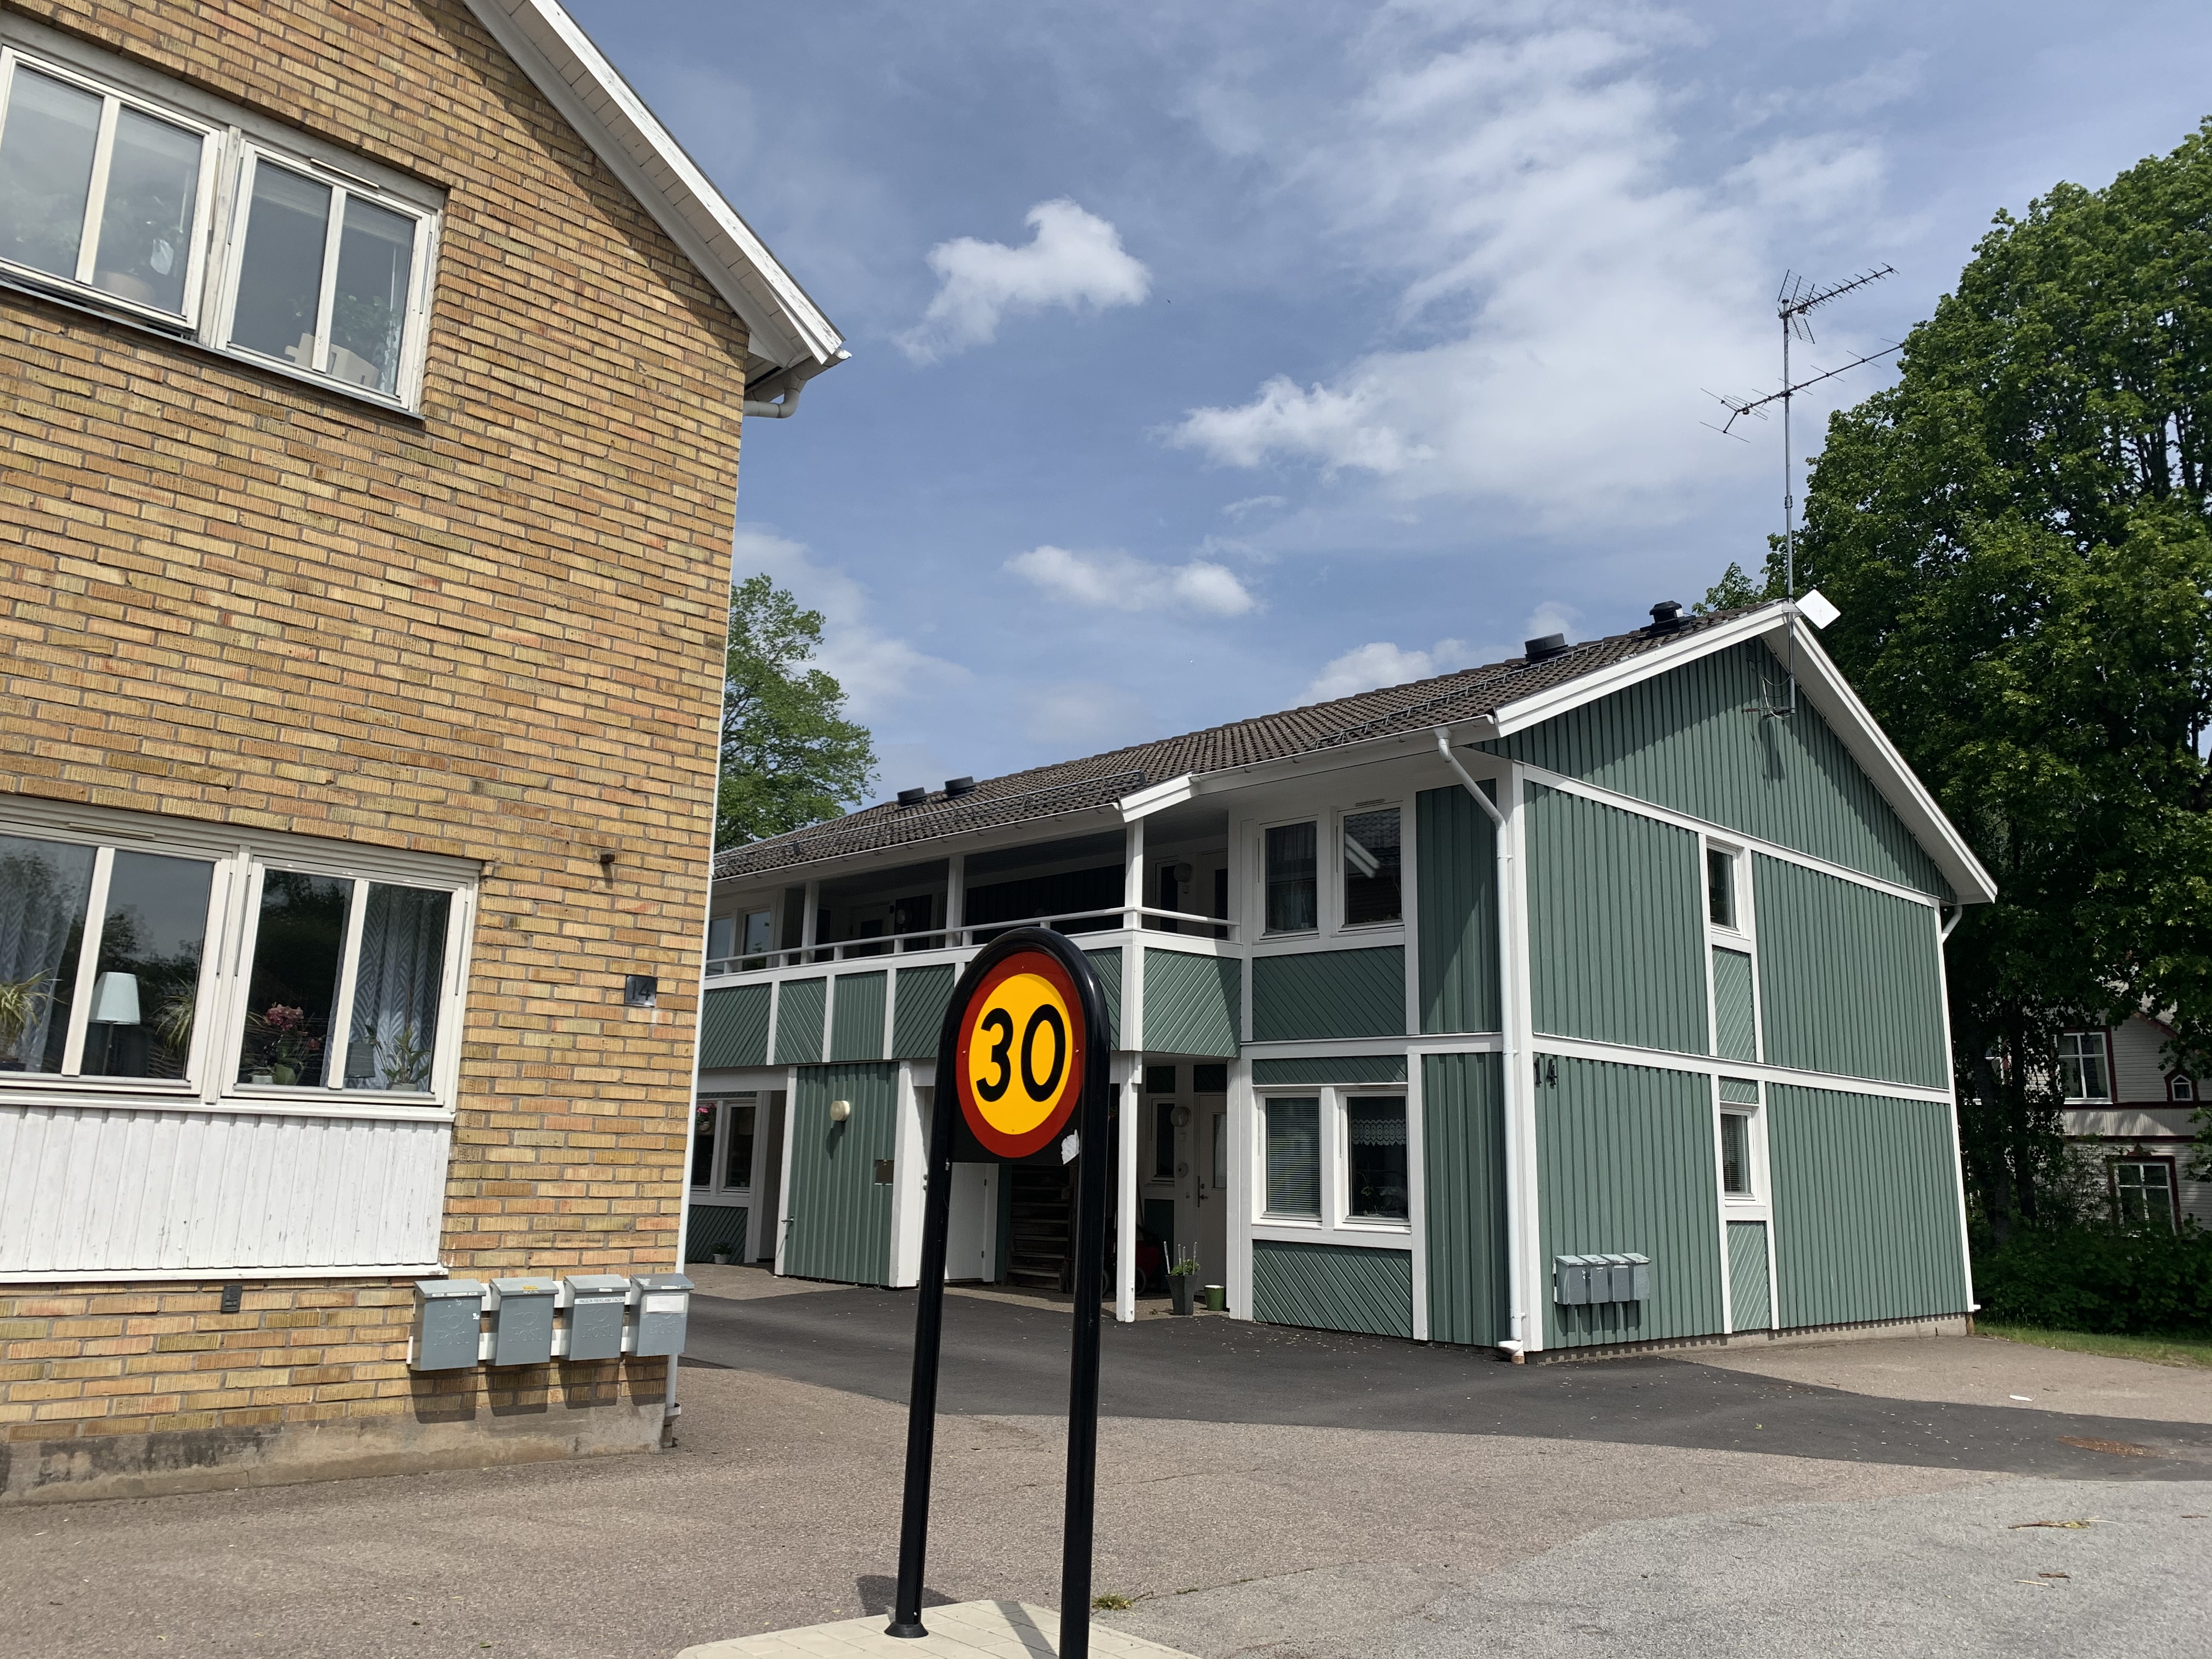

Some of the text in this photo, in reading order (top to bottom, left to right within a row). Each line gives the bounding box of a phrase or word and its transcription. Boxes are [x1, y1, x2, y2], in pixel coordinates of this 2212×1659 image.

[631, 980, 651, 1001] 14
[976, 1004, 1065, 1102] 30
[1534, 1057, 1558, 1086] 14
[509, 1327, 543, 1342] Post
[582, 1323, 614, 1338] Post
[649, 1321, 679, 1334] Post
[433, 1330, 469, 1346] Post
